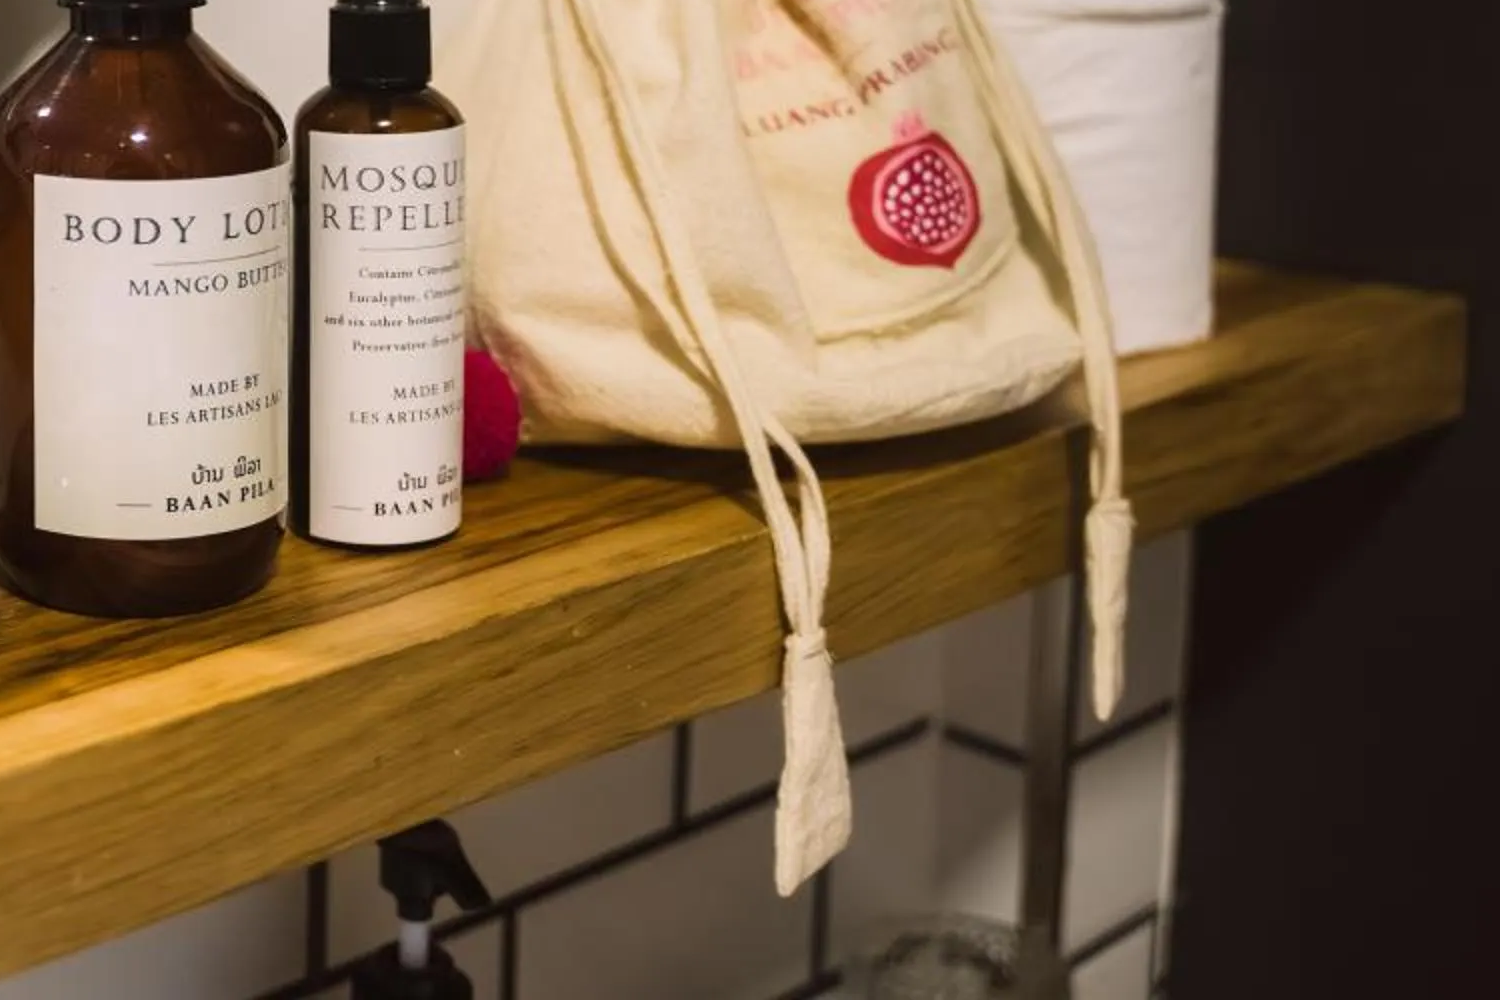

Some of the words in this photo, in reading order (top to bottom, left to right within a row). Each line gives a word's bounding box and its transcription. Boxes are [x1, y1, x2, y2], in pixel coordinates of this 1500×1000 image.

[63, 213, 197, 246] BODY
[128, 273, 230, 297] MANGO
[190, 378, 240, 398] MADE
[244, 374, 260, 390] BY
[392, 383, 440, 401] MADE
[147, 409, 180, 427] LES
[185, 397, 262, 424] ARTISANS
[349, 410, 380, 425] LES
[165, 490, 231, 513] BAAN
[240, 477, 275, 503] PILA
[374, 497, 435, 517] BAAN
